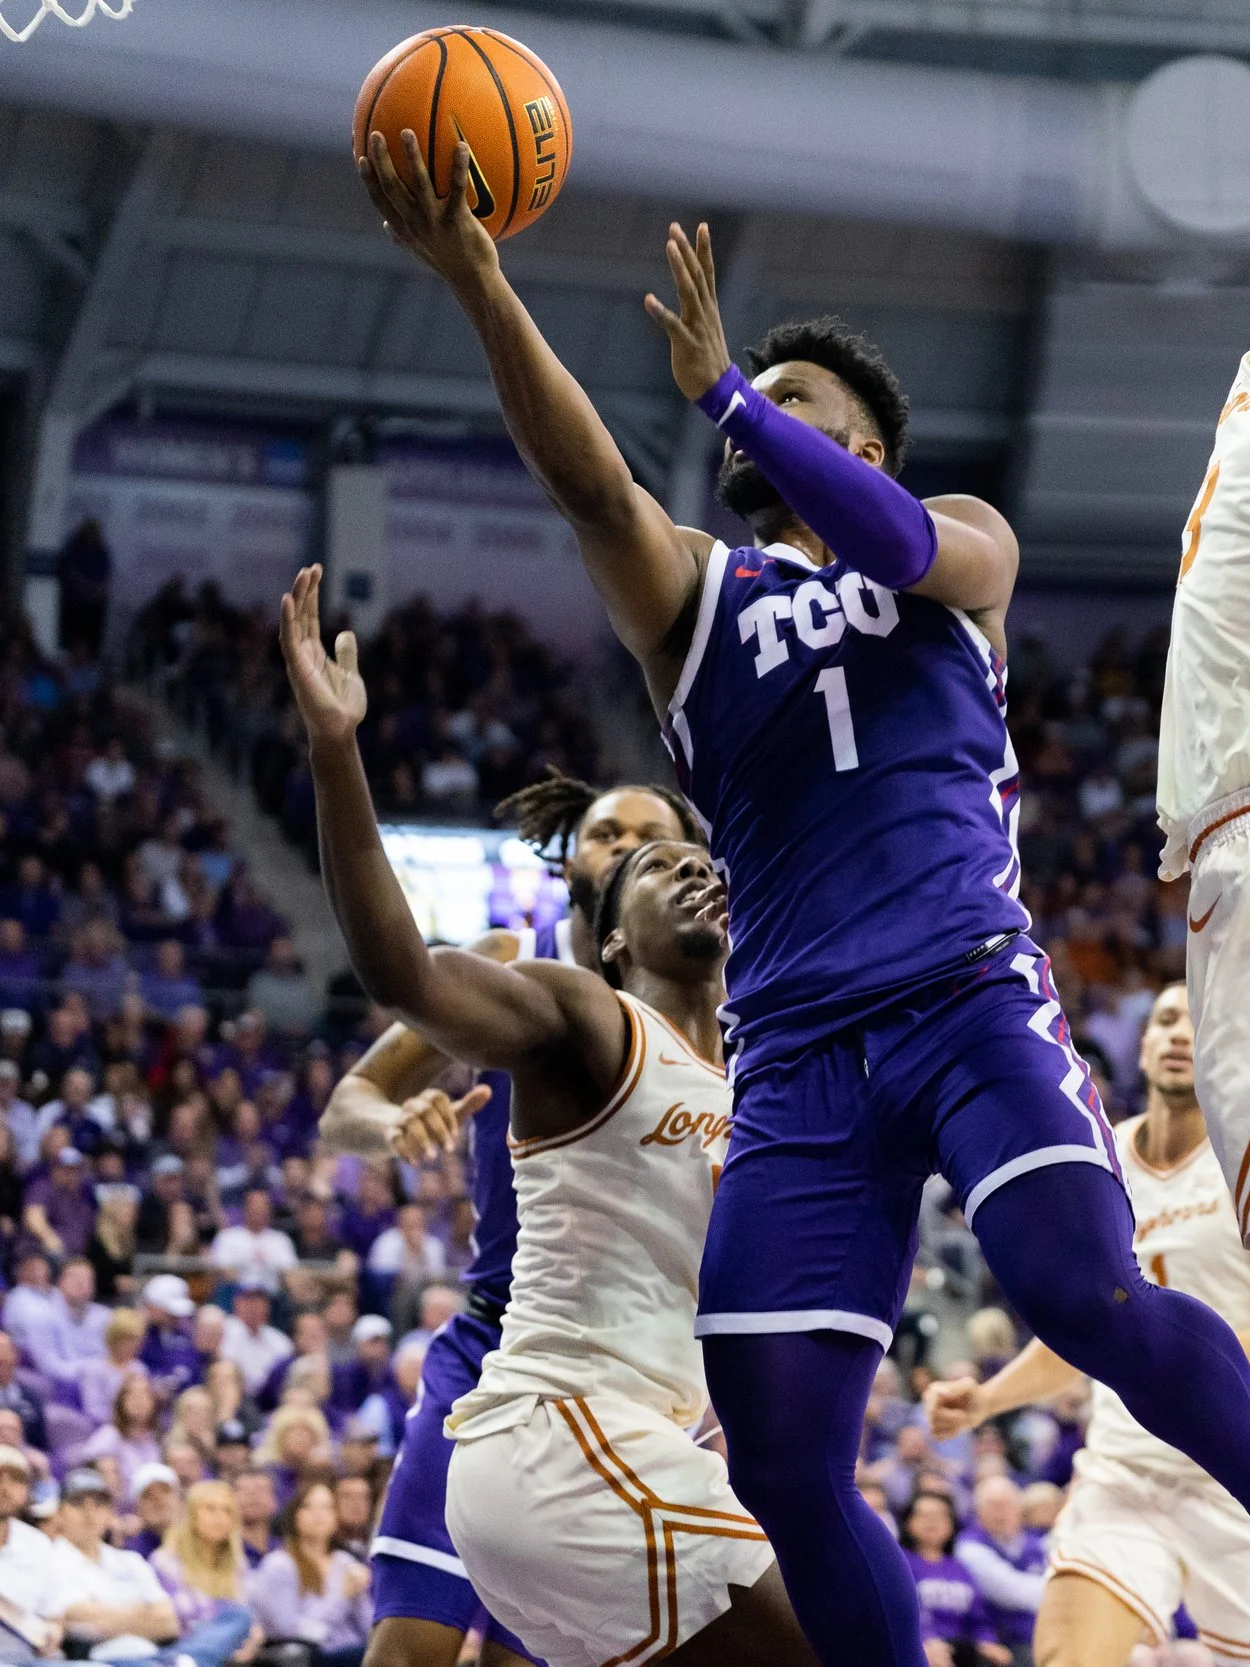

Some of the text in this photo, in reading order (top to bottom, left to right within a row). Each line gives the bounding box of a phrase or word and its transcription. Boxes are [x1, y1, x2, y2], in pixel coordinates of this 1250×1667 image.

[522, 98, 557, 213] ELITE
[737, 572, 900, 680] TCU
[813, 666, 859, 772] 1
[640, 1102, 732, 1149] Long
